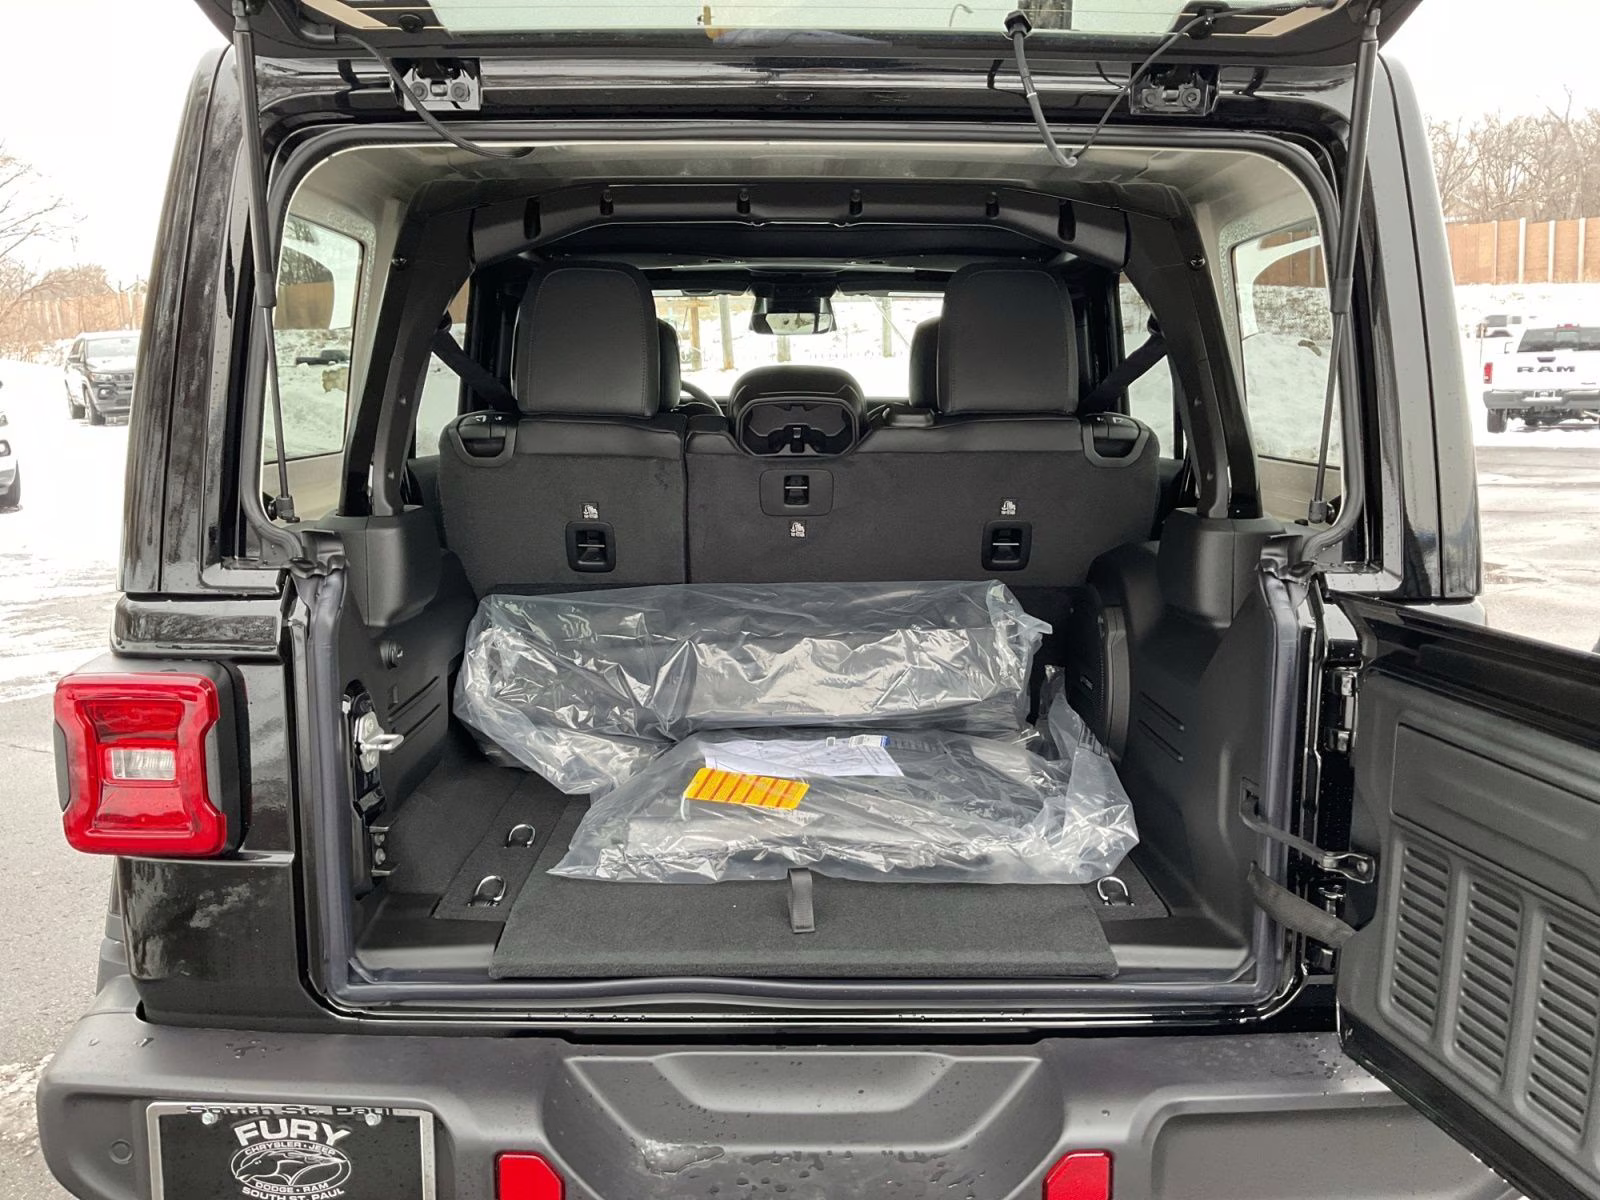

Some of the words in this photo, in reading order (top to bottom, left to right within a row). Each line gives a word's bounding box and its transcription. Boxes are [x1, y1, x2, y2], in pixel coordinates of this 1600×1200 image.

[234, 1118, 351, 1147] FURY
[244, 1141, 302, 1156] CHRYSLER
[308, 1143, 336, 1156] JEEP
[241, 1186, 286, 1200] SOUTH
[311, 1187, 345, 1200] PAUL
[255, 1182, 294, 1193] DODGE
[302, 1182, 329, 1193] RAM
